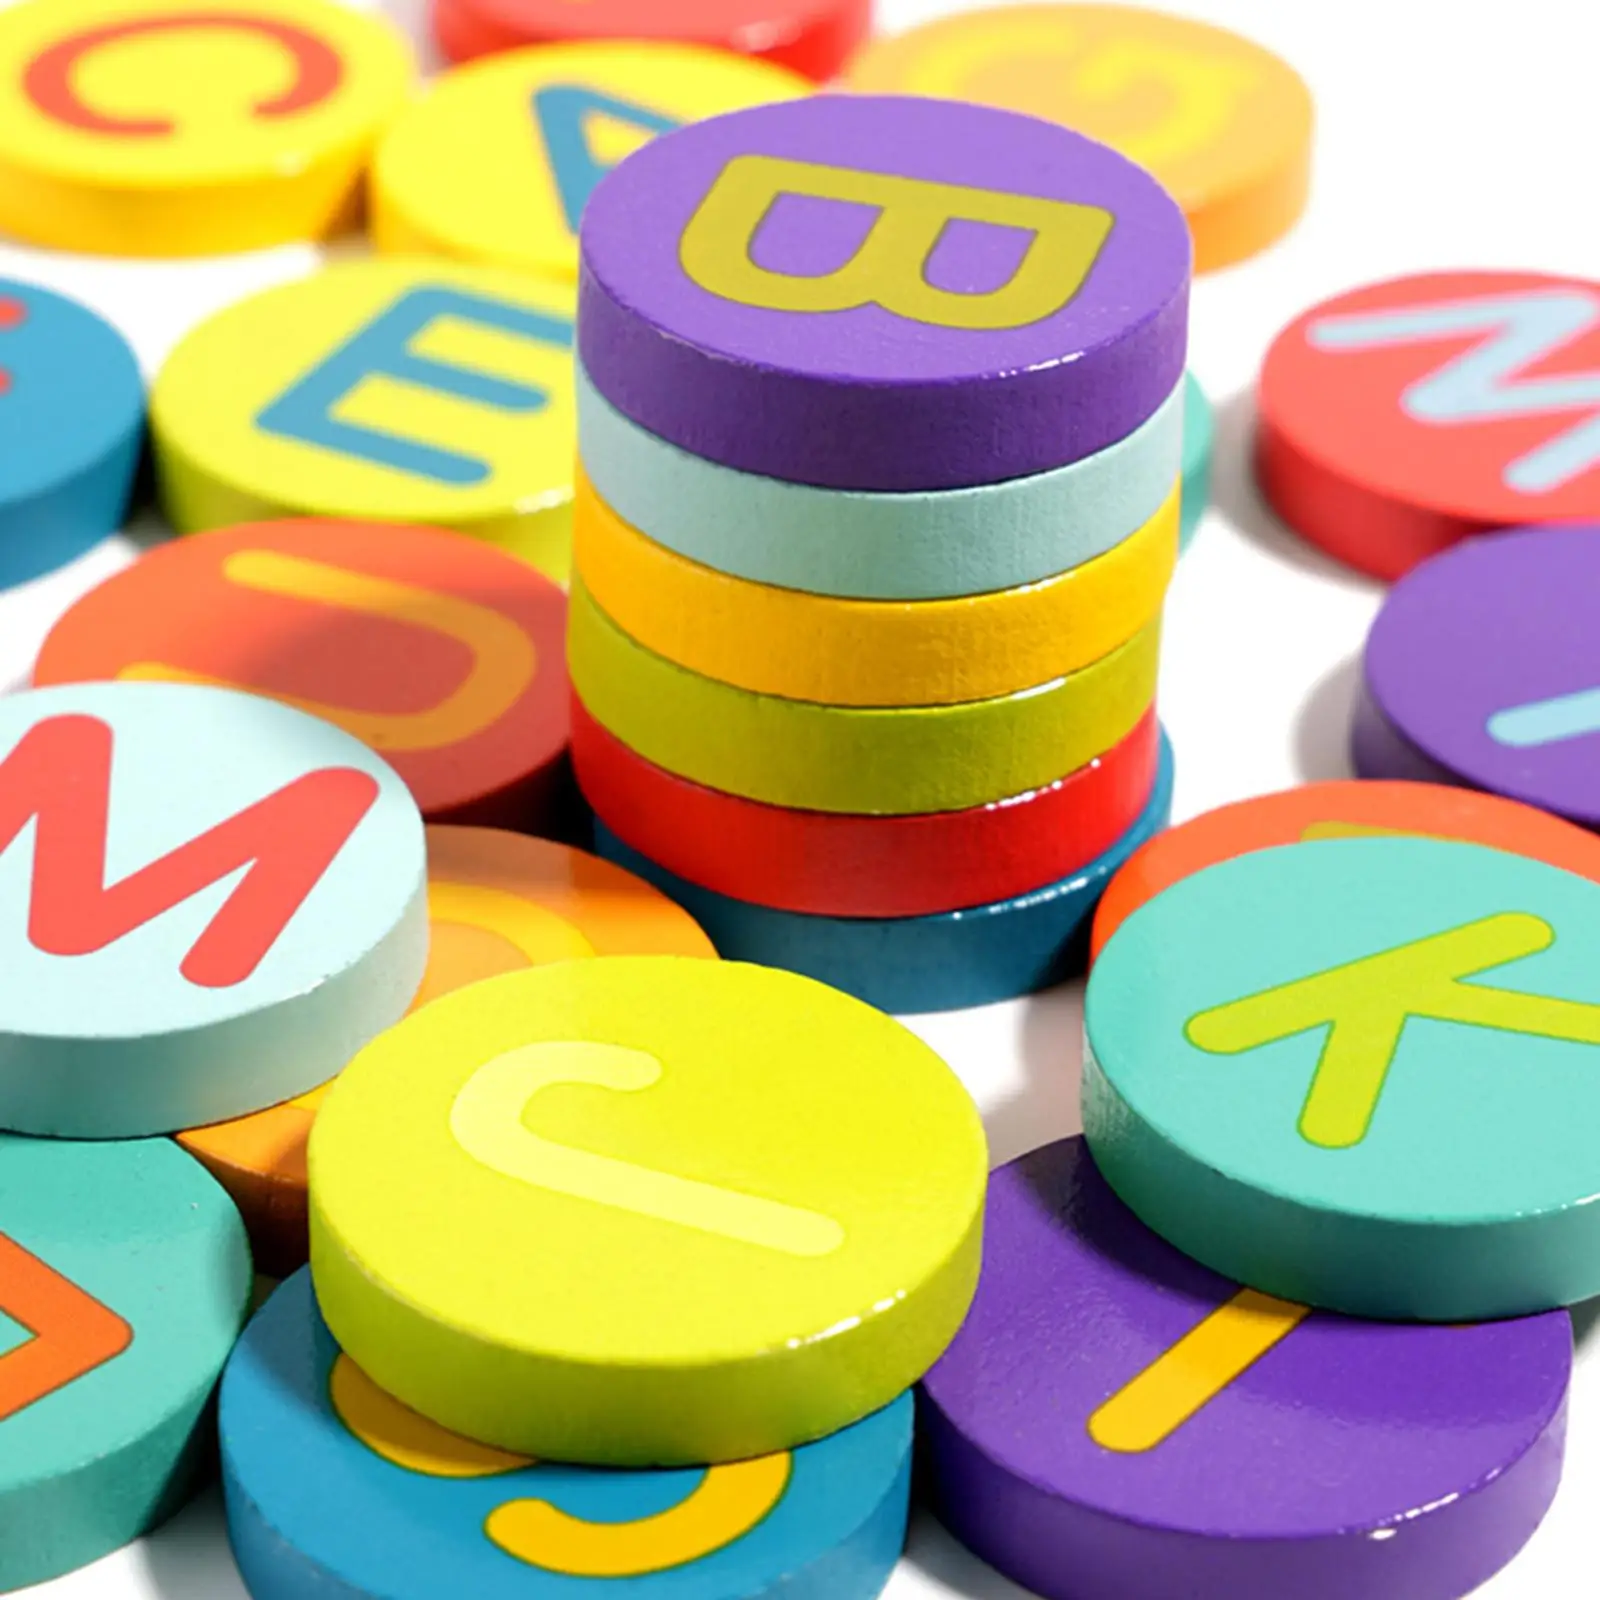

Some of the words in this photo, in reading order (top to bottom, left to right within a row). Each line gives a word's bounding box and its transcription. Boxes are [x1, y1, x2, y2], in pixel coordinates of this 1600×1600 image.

[23, 13, 344, 137] C
[678, 154, 1116, 331] B
[252, 284, 576, 485] E
[115, 549, 537, 752] U
[0, 713, 381, 989] M
[1183, 911, 1600, 1150] K
[449, 1040, 845, 1256] J
